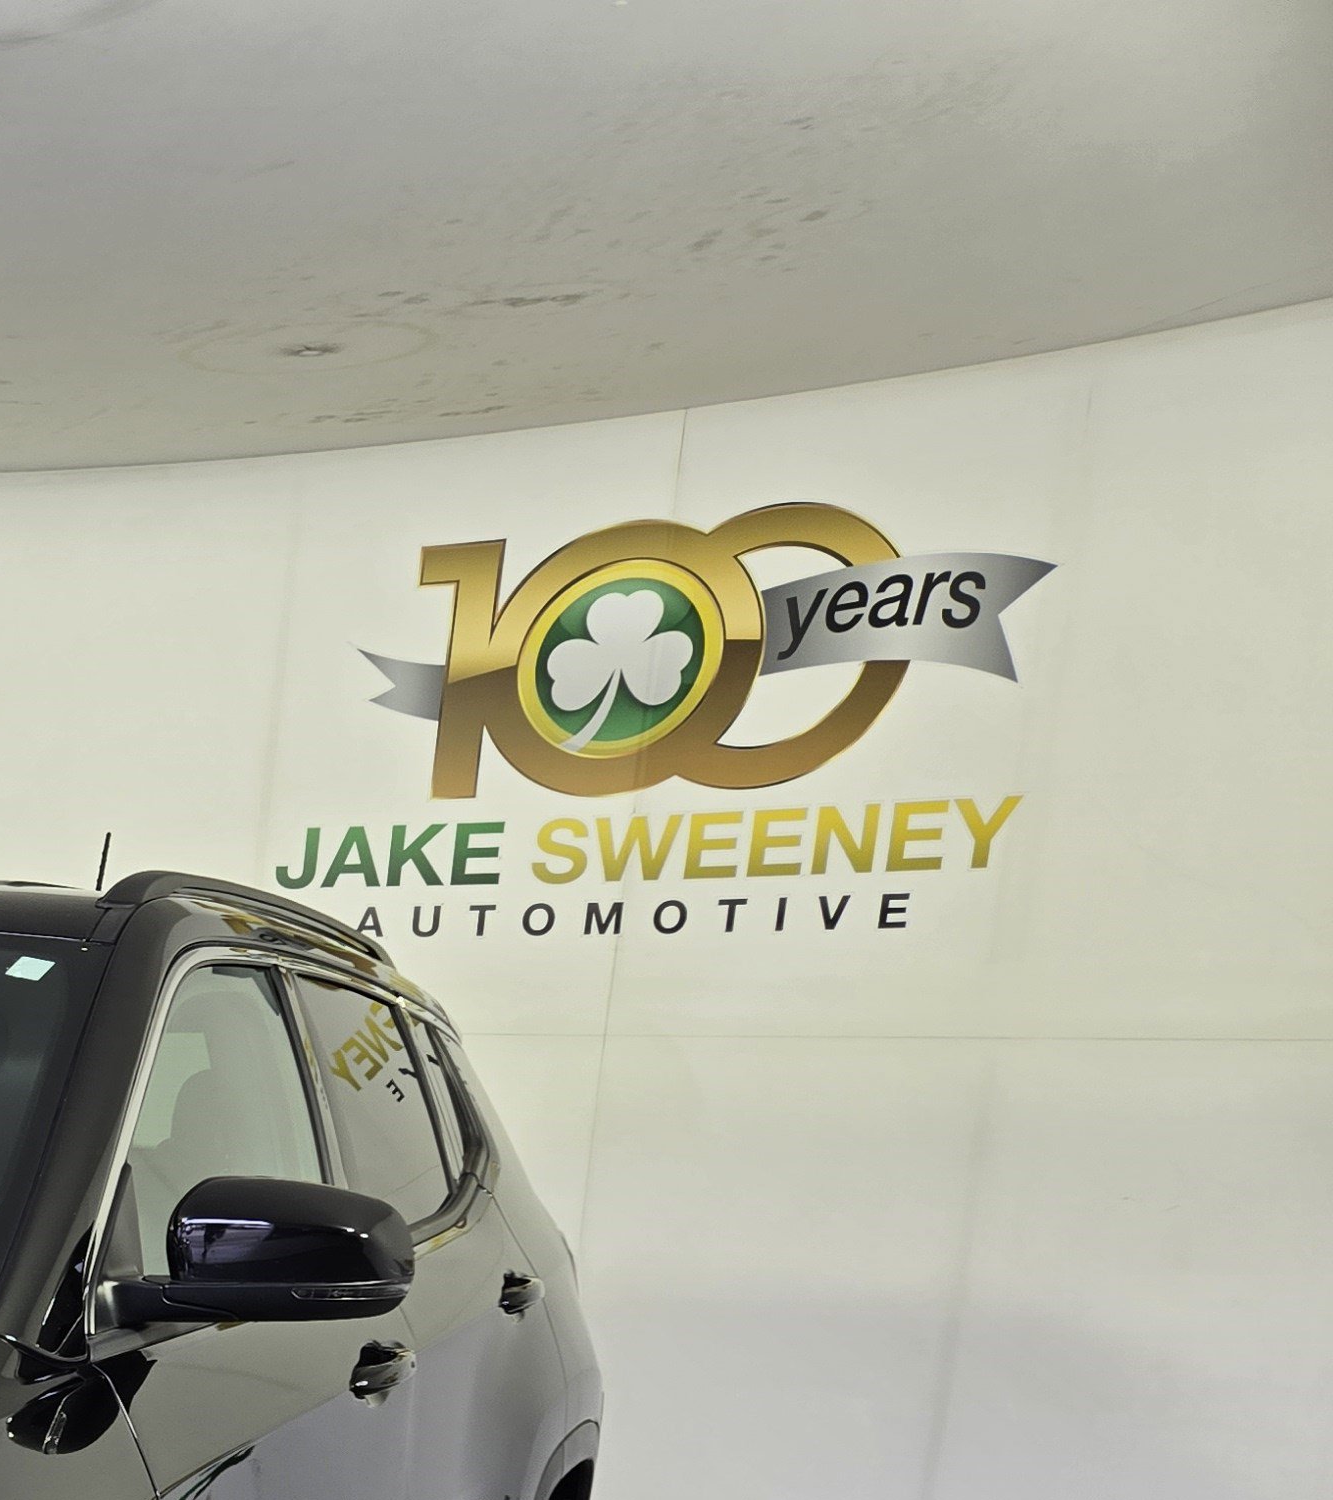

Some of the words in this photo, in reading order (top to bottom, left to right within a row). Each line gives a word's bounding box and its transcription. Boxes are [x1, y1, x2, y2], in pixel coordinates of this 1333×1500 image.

[419, 501, 910, 799] 100
[778, 568, 987, 661] years
[275, 821, 505, 889] JAKE
[531, 795, 1024, 884] SWEENEY
[356, 893, 912, 938] AUTOMOTIVE
